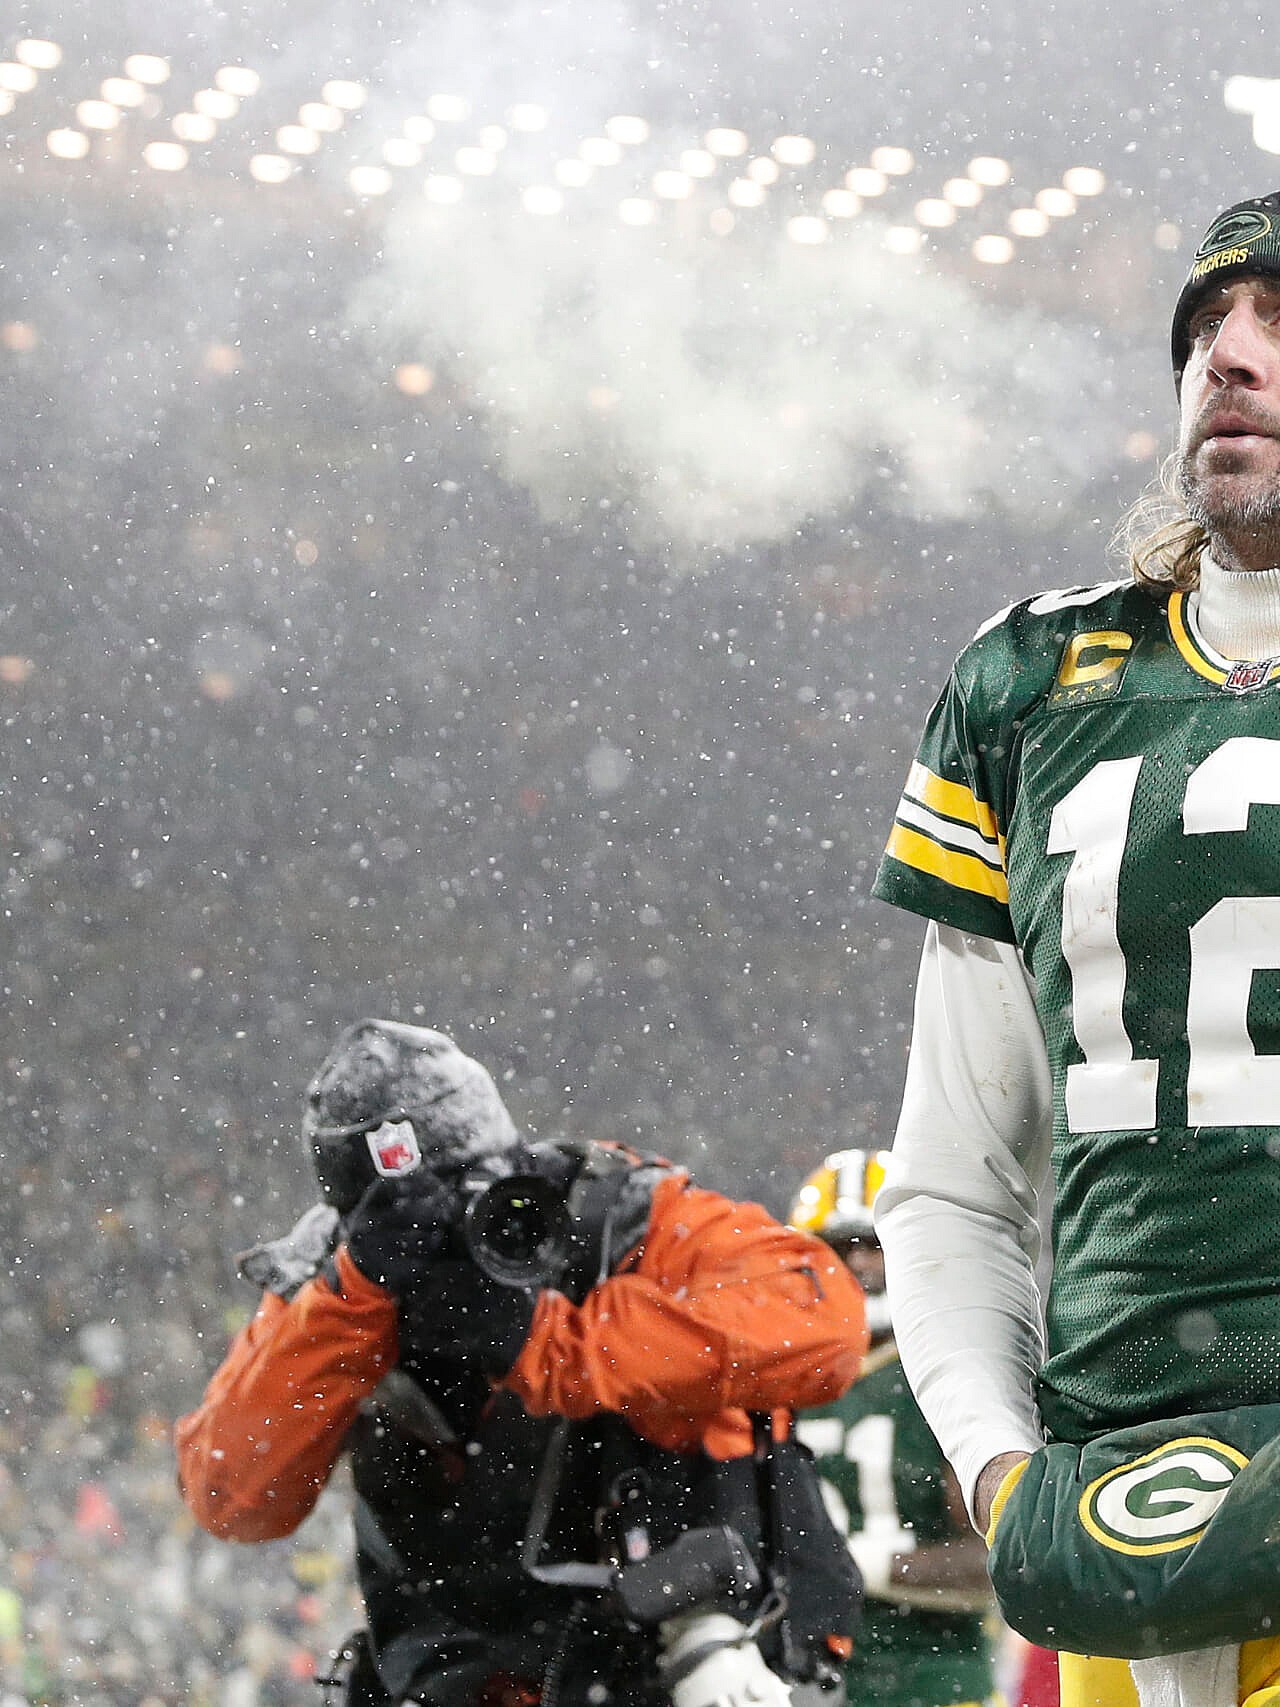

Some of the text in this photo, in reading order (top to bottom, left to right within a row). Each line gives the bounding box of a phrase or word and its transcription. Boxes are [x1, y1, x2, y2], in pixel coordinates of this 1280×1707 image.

[1058, 630, 1133, 687] C
[1230, 669, 1259, 686] NFL
[1096, 1452, 1234, 1538] G
